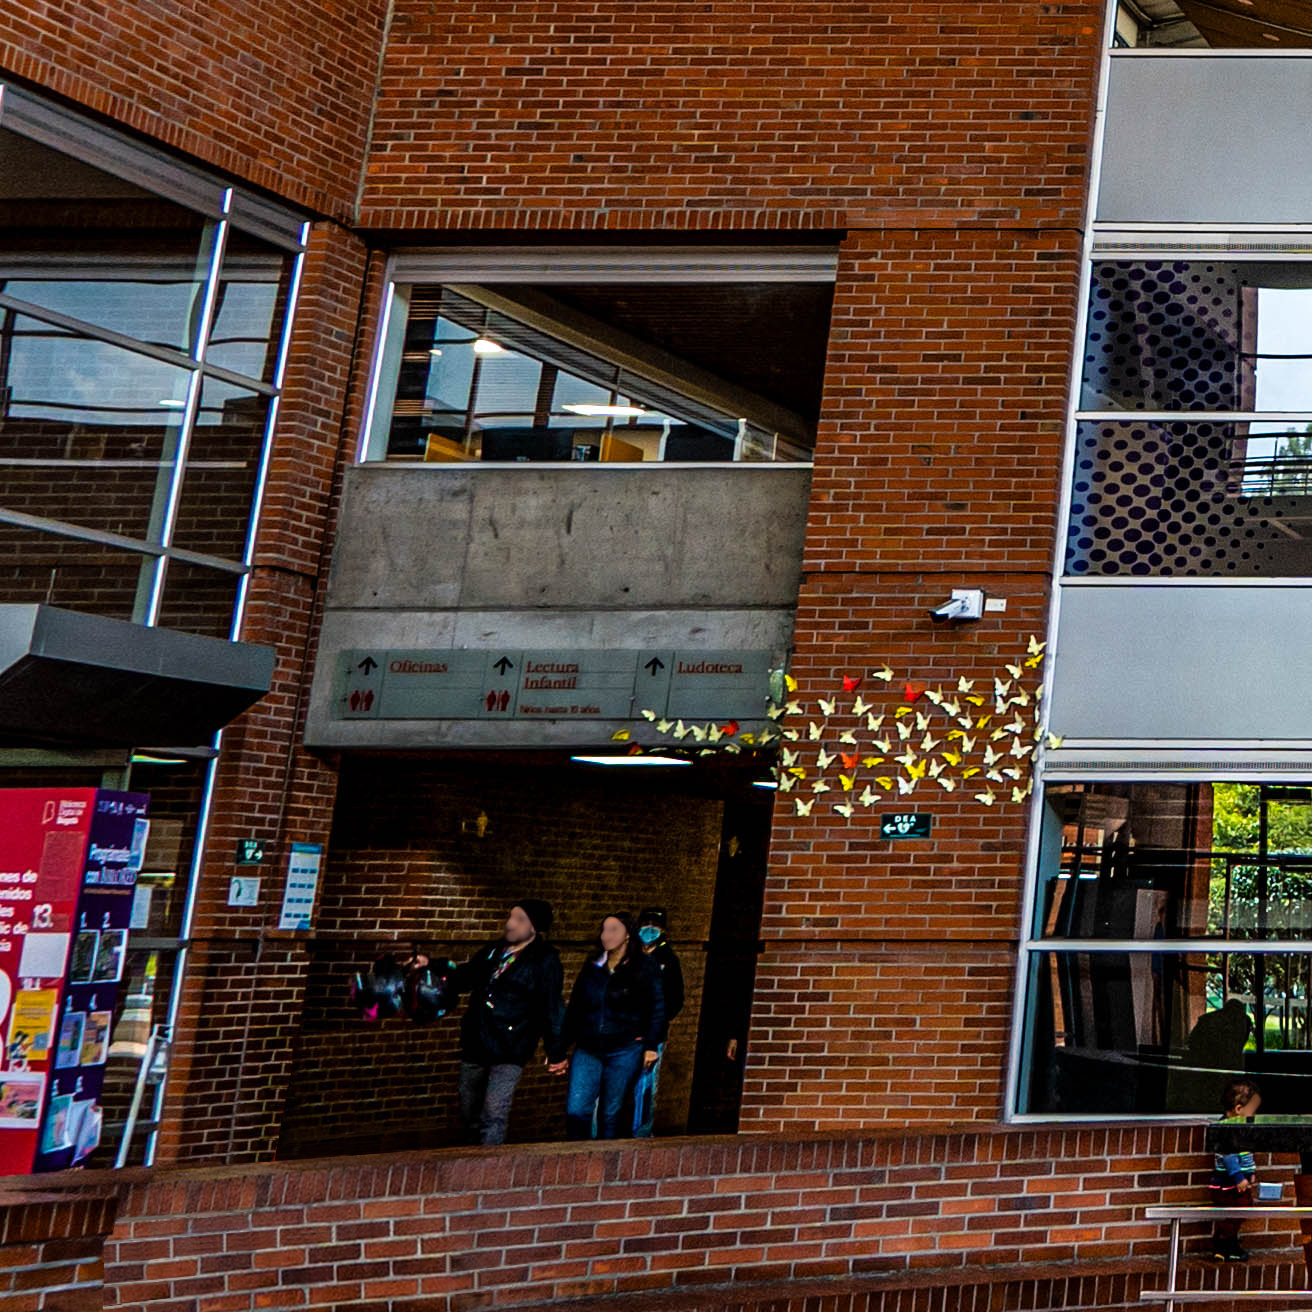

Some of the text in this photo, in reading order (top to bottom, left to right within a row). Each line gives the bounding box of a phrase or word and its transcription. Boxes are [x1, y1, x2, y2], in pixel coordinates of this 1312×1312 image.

[389, 659, 448, 674] Oficinas
[526, 660, 580, 674] Lectura
[677, 660, 743, 674] Ludoteca
[523, 676, 577, 689] Infantil
[894, 814, 917, 823] DEA
[22, 869, 38, 883] de
[33, 903, 54, 928] 13.
